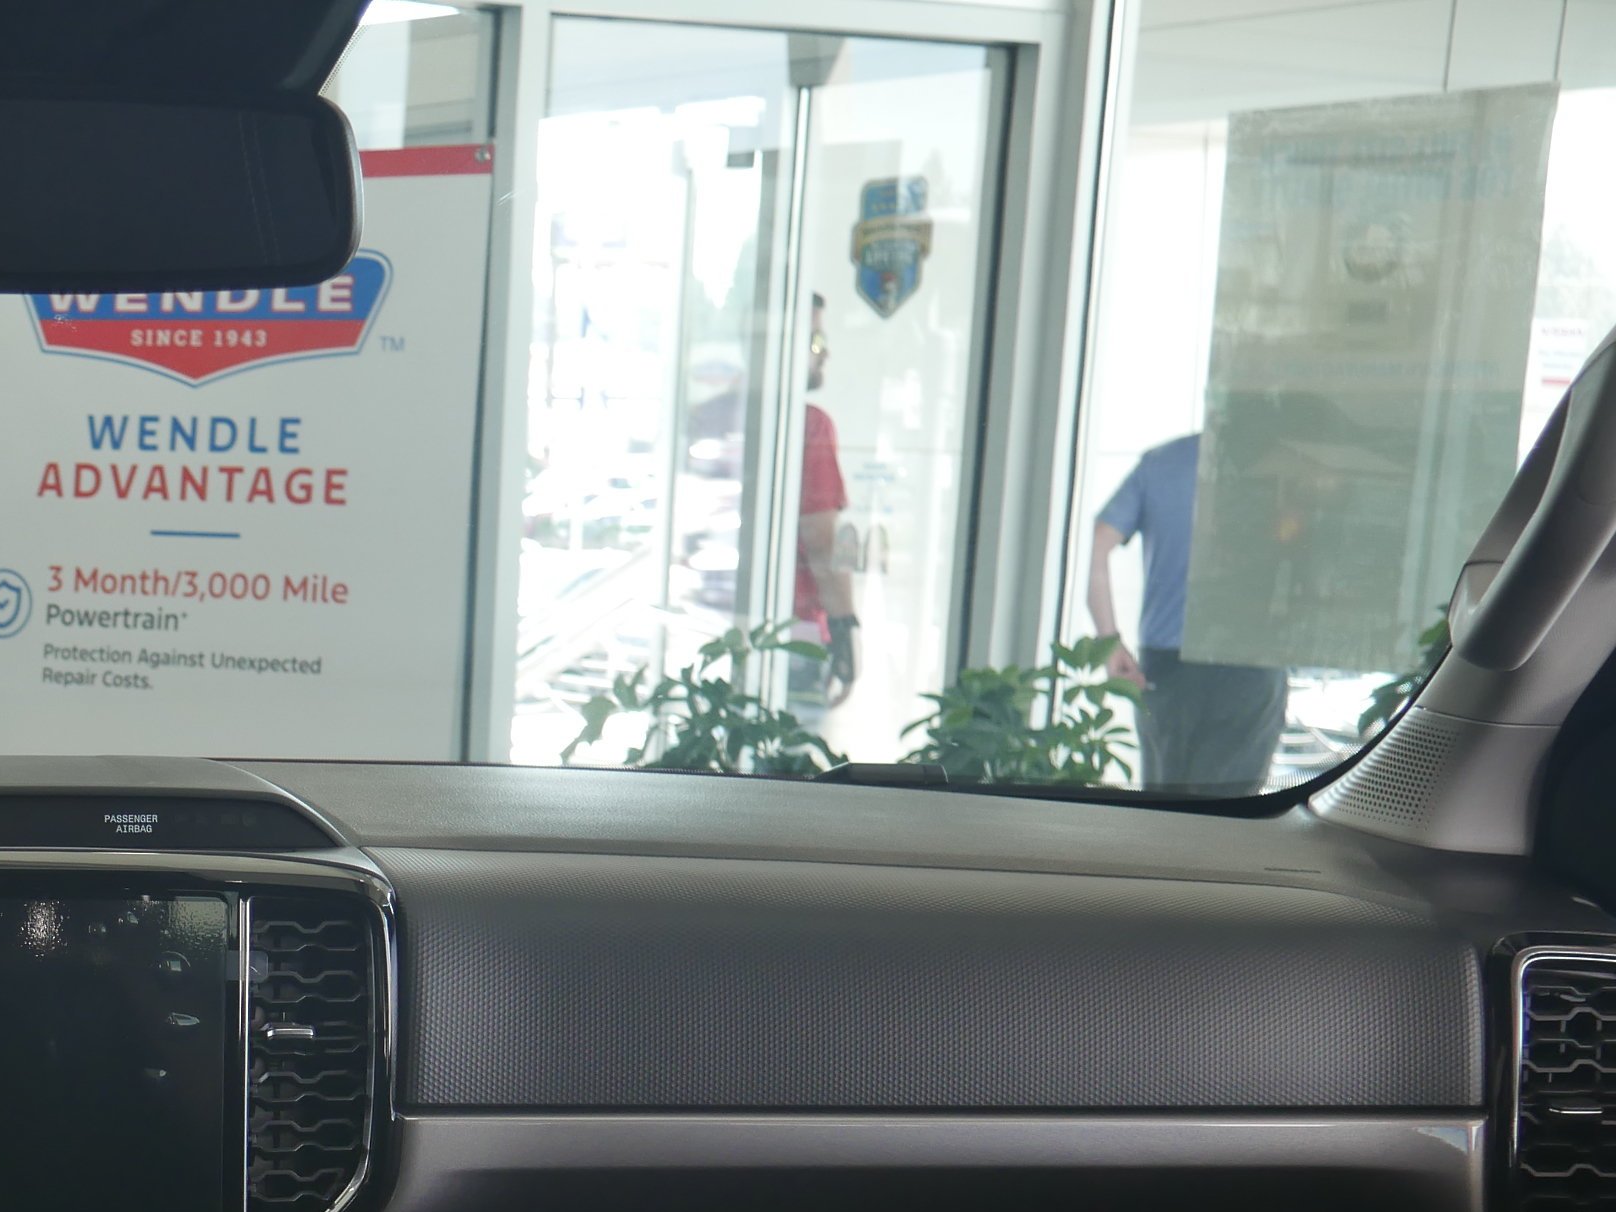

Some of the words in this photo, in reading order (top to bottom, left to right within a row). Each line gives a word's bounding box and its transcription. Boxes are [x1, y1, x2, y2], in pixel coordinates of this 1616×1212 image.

[130, 329, 203, 347] SINCE
[213, 330, 268, 347] 1943
[380, 336, 405, 352] TM
[87, 414, 302, 454] WENDLE
[36, 462, 349, 506] ADVANTAGE
[47, 566, 64, 592] 3
[74, 566, 271, 602] Month/3,000
[283, 574, 350, 604] Mile
[43, 644, 132, 664] Protection
[137, 649, 205, 670] Against
[211, 653, 322, 675] Unexpected
[42, 668, 97, 688] Repair
[102, 670, 154, 690] Costs.
[104, 814, 159, 824] PASSENGER
[115, 824, 153, 834] AIRBAG
